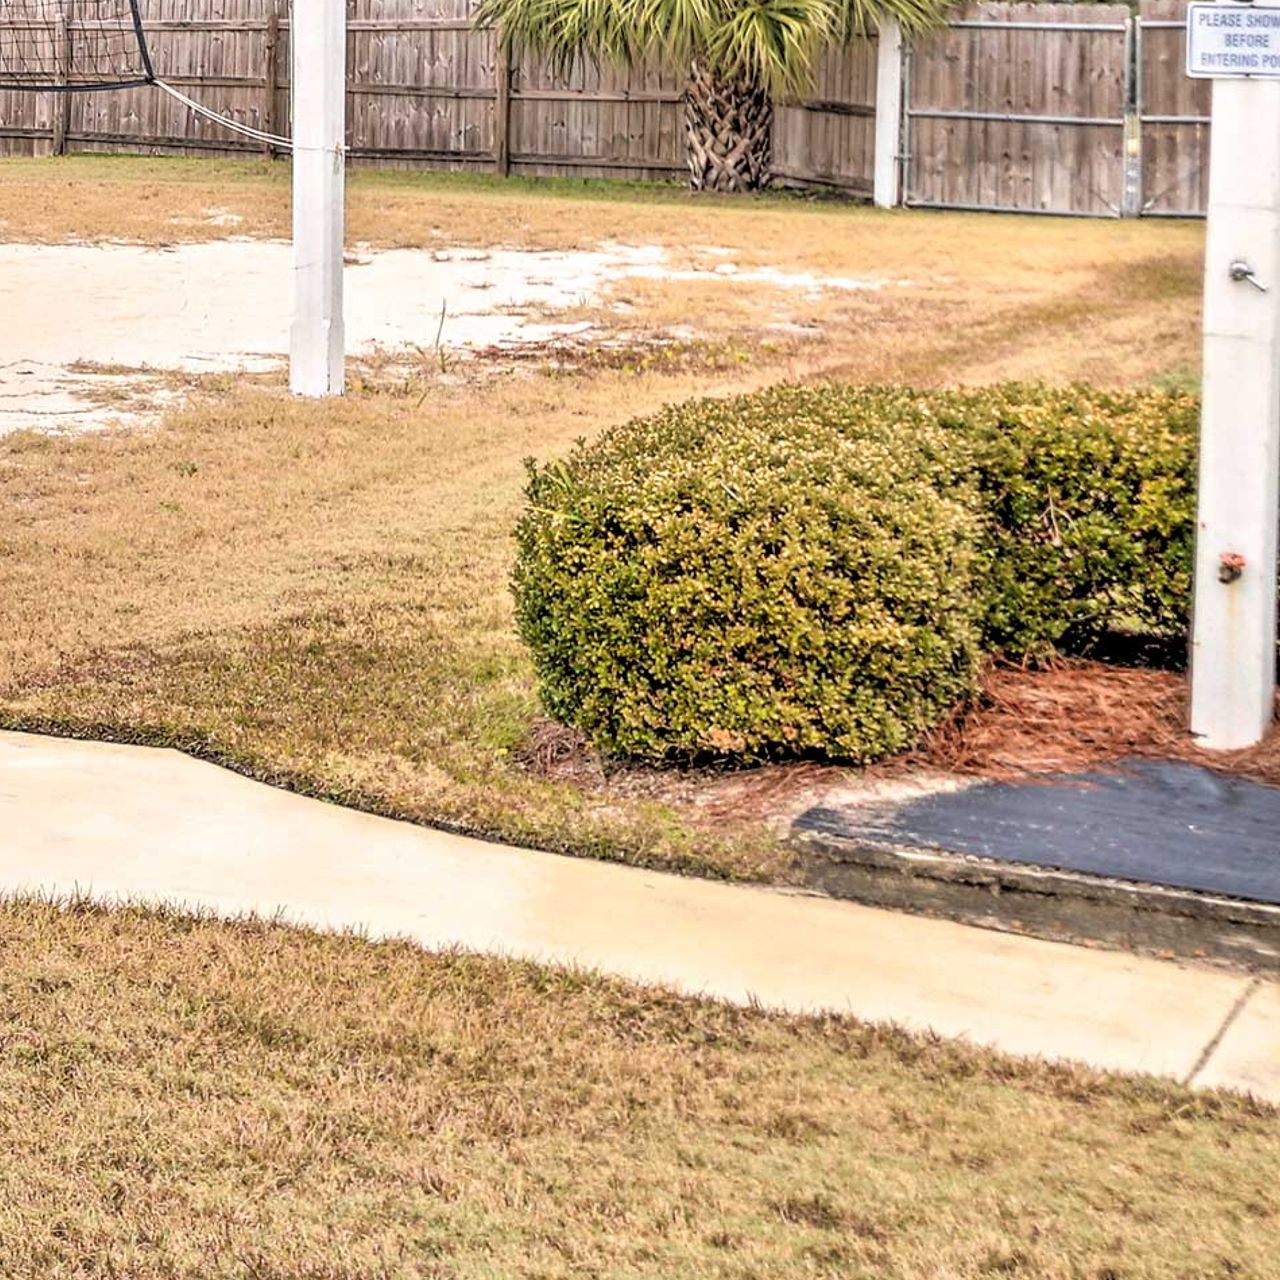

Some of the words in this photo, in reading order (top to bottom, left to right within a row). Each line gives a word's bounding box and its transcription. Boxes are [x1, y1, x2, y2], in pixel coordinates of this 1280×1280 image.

[1199, 13, 1241, 27] PLEASE
[1224, 34, 1269, 48] BEFORE
[1200, 52, 1259, 67] ENTERING
[1262, 54, 1280, 68] PO
